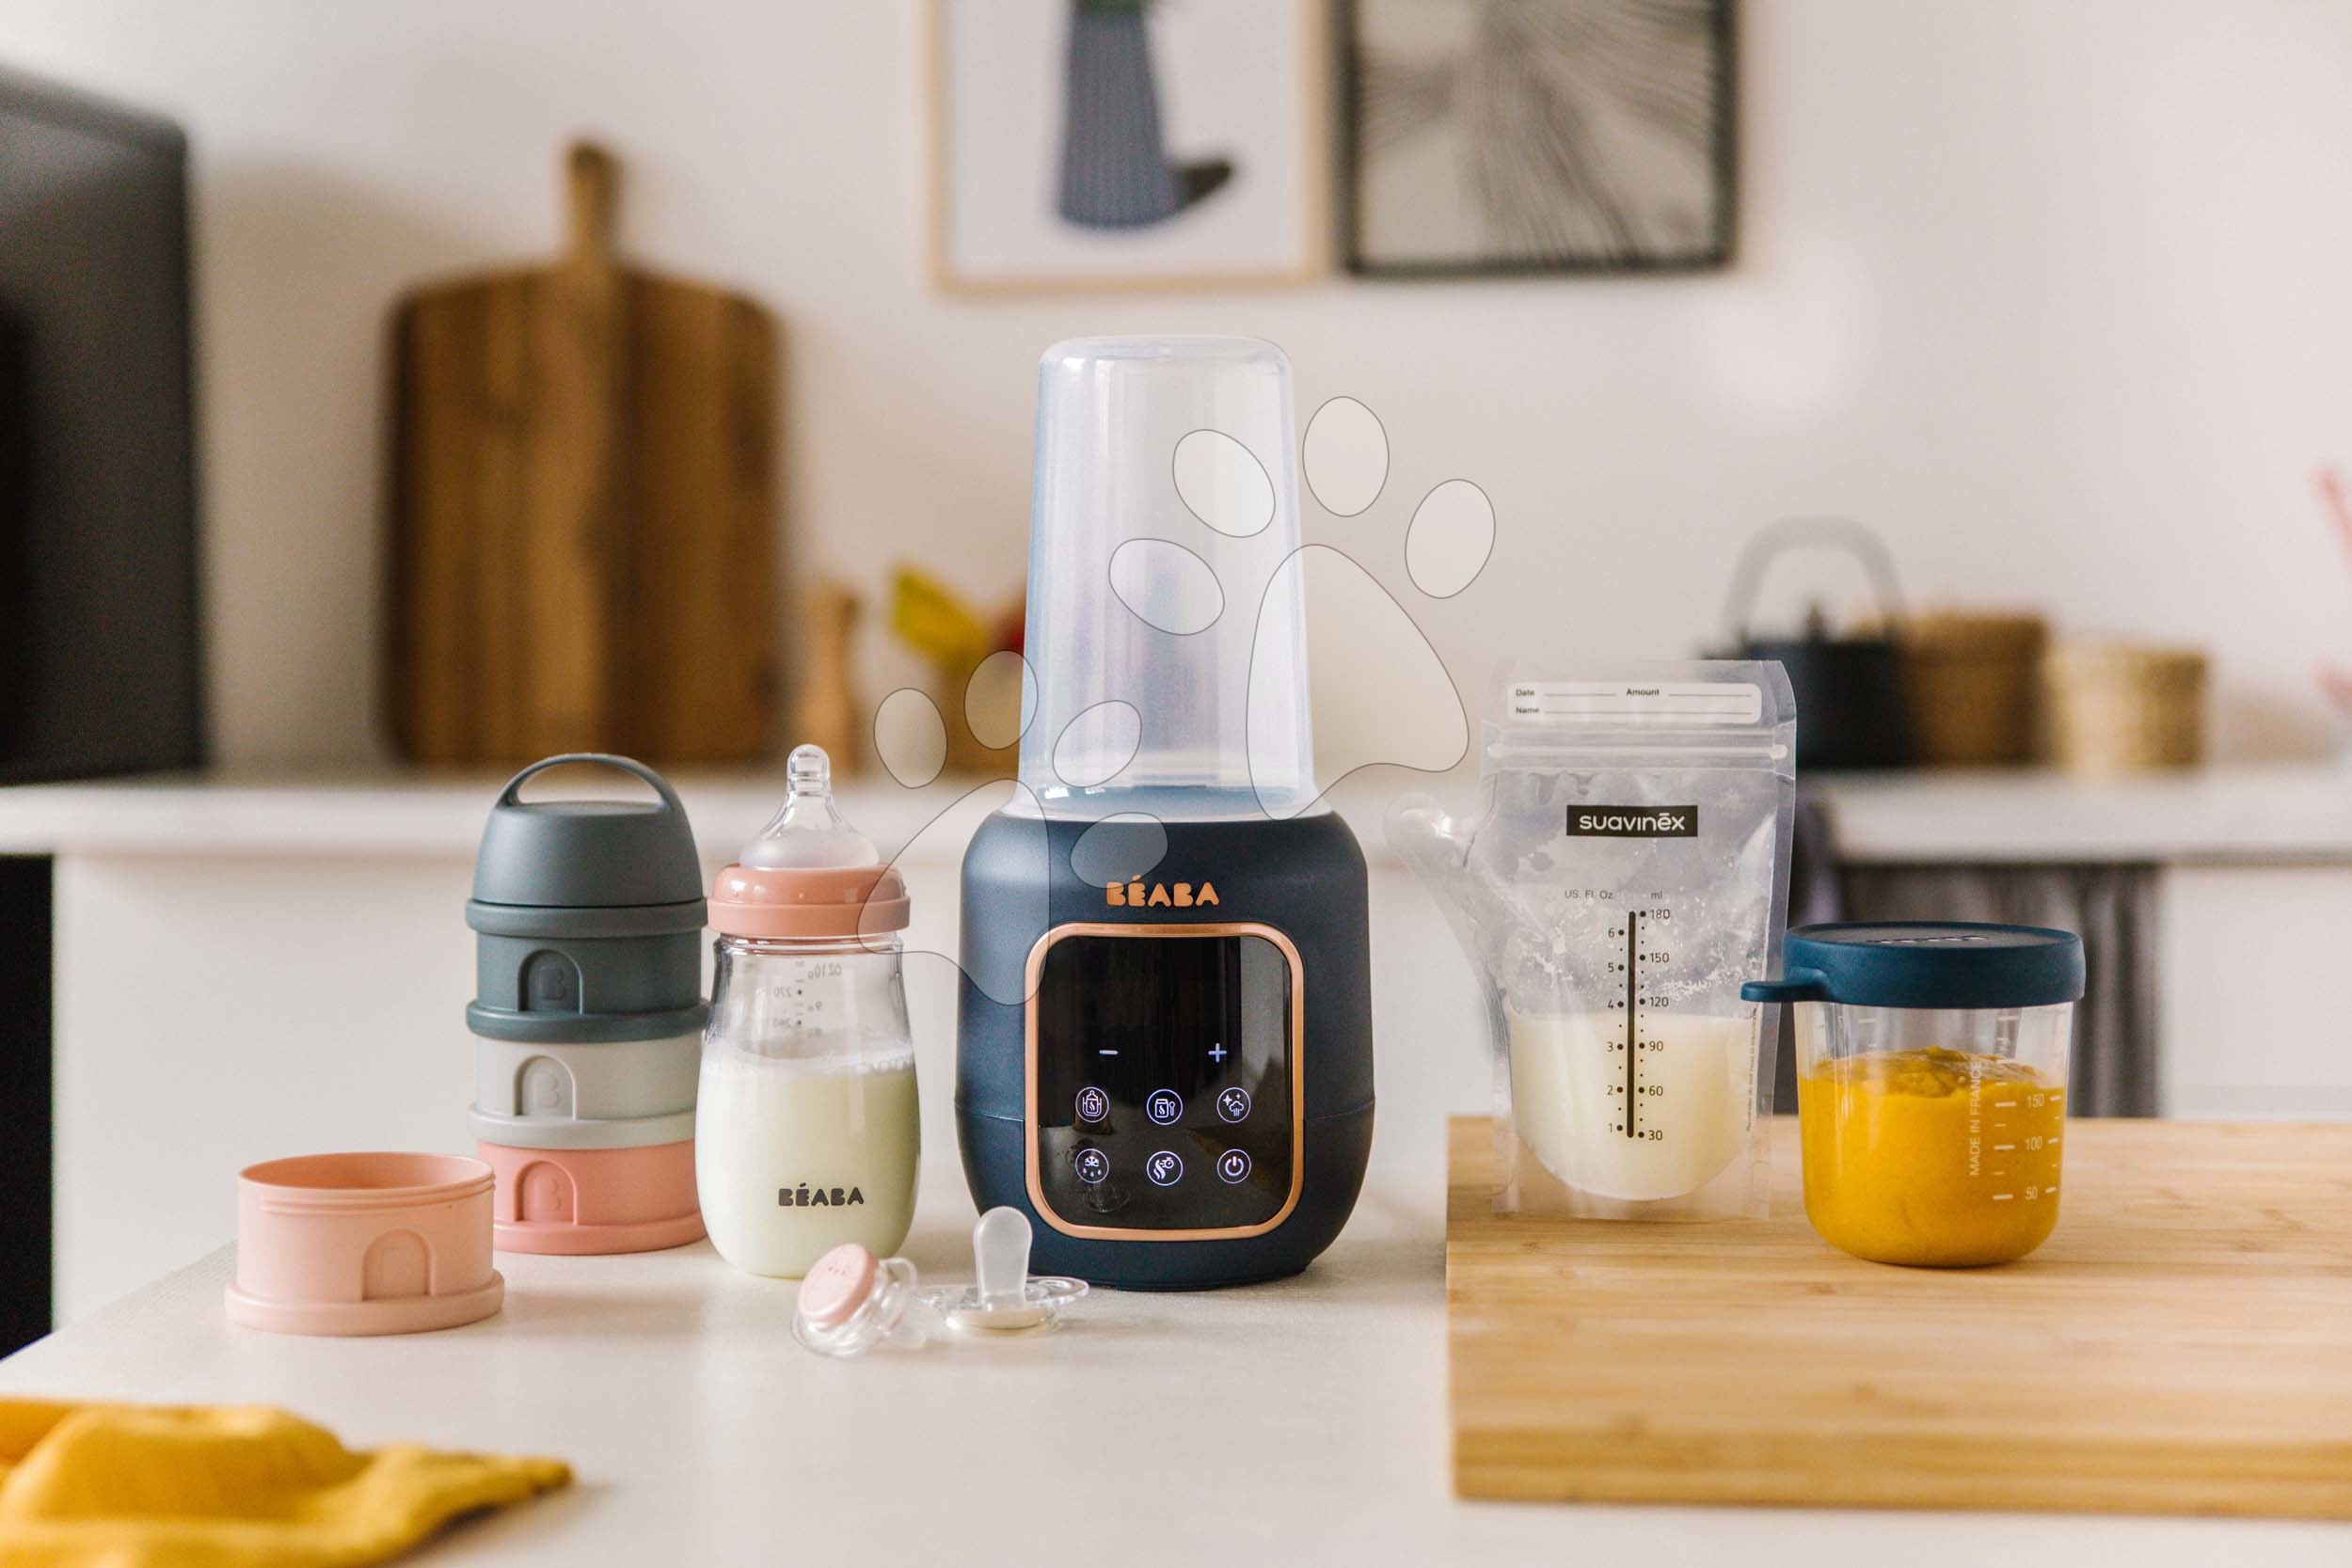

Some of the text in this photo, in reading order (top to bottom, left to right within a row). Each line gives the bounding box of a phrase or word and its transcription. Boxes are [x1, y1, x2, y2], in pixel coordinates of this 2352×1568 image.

[1516, 688, 1661, 697] Date Amount
[1516, 706, 1540, 715] Name
[1105, 875, 1220, 908] BÉABA
[1598, 889, 1613, 900] Oz
[1650, 890, 1663, 900] ml
[1650, 909, 1671, 920] 180
[1608, 927, 1615, 939] 6
[1649, 952, 1670, 964] 150
[1607, 961, 1614, 974] 5
[1607, 998, 1614, 1010] 4
[1649, 996, 1670, 1008] 120
[1607, 1041, 1614, 1053] 3
[1648, 1040, 1664, 1053] 90
[1607, 1085, 1613, 1097] 2
[1648, 1085, 1664, 1097] 60
[1969, 1061, 1981, 1176] MADE IN FRANCE
[1608, 1122, 1613, 1134] 1
[1648, 1130, 1664, 1142] 30
[2025, 1135, 2043, 1152] 100
[778, 1181, 865, 1207] BÉABA
[2025, 1185, 2039, 1200] 50
